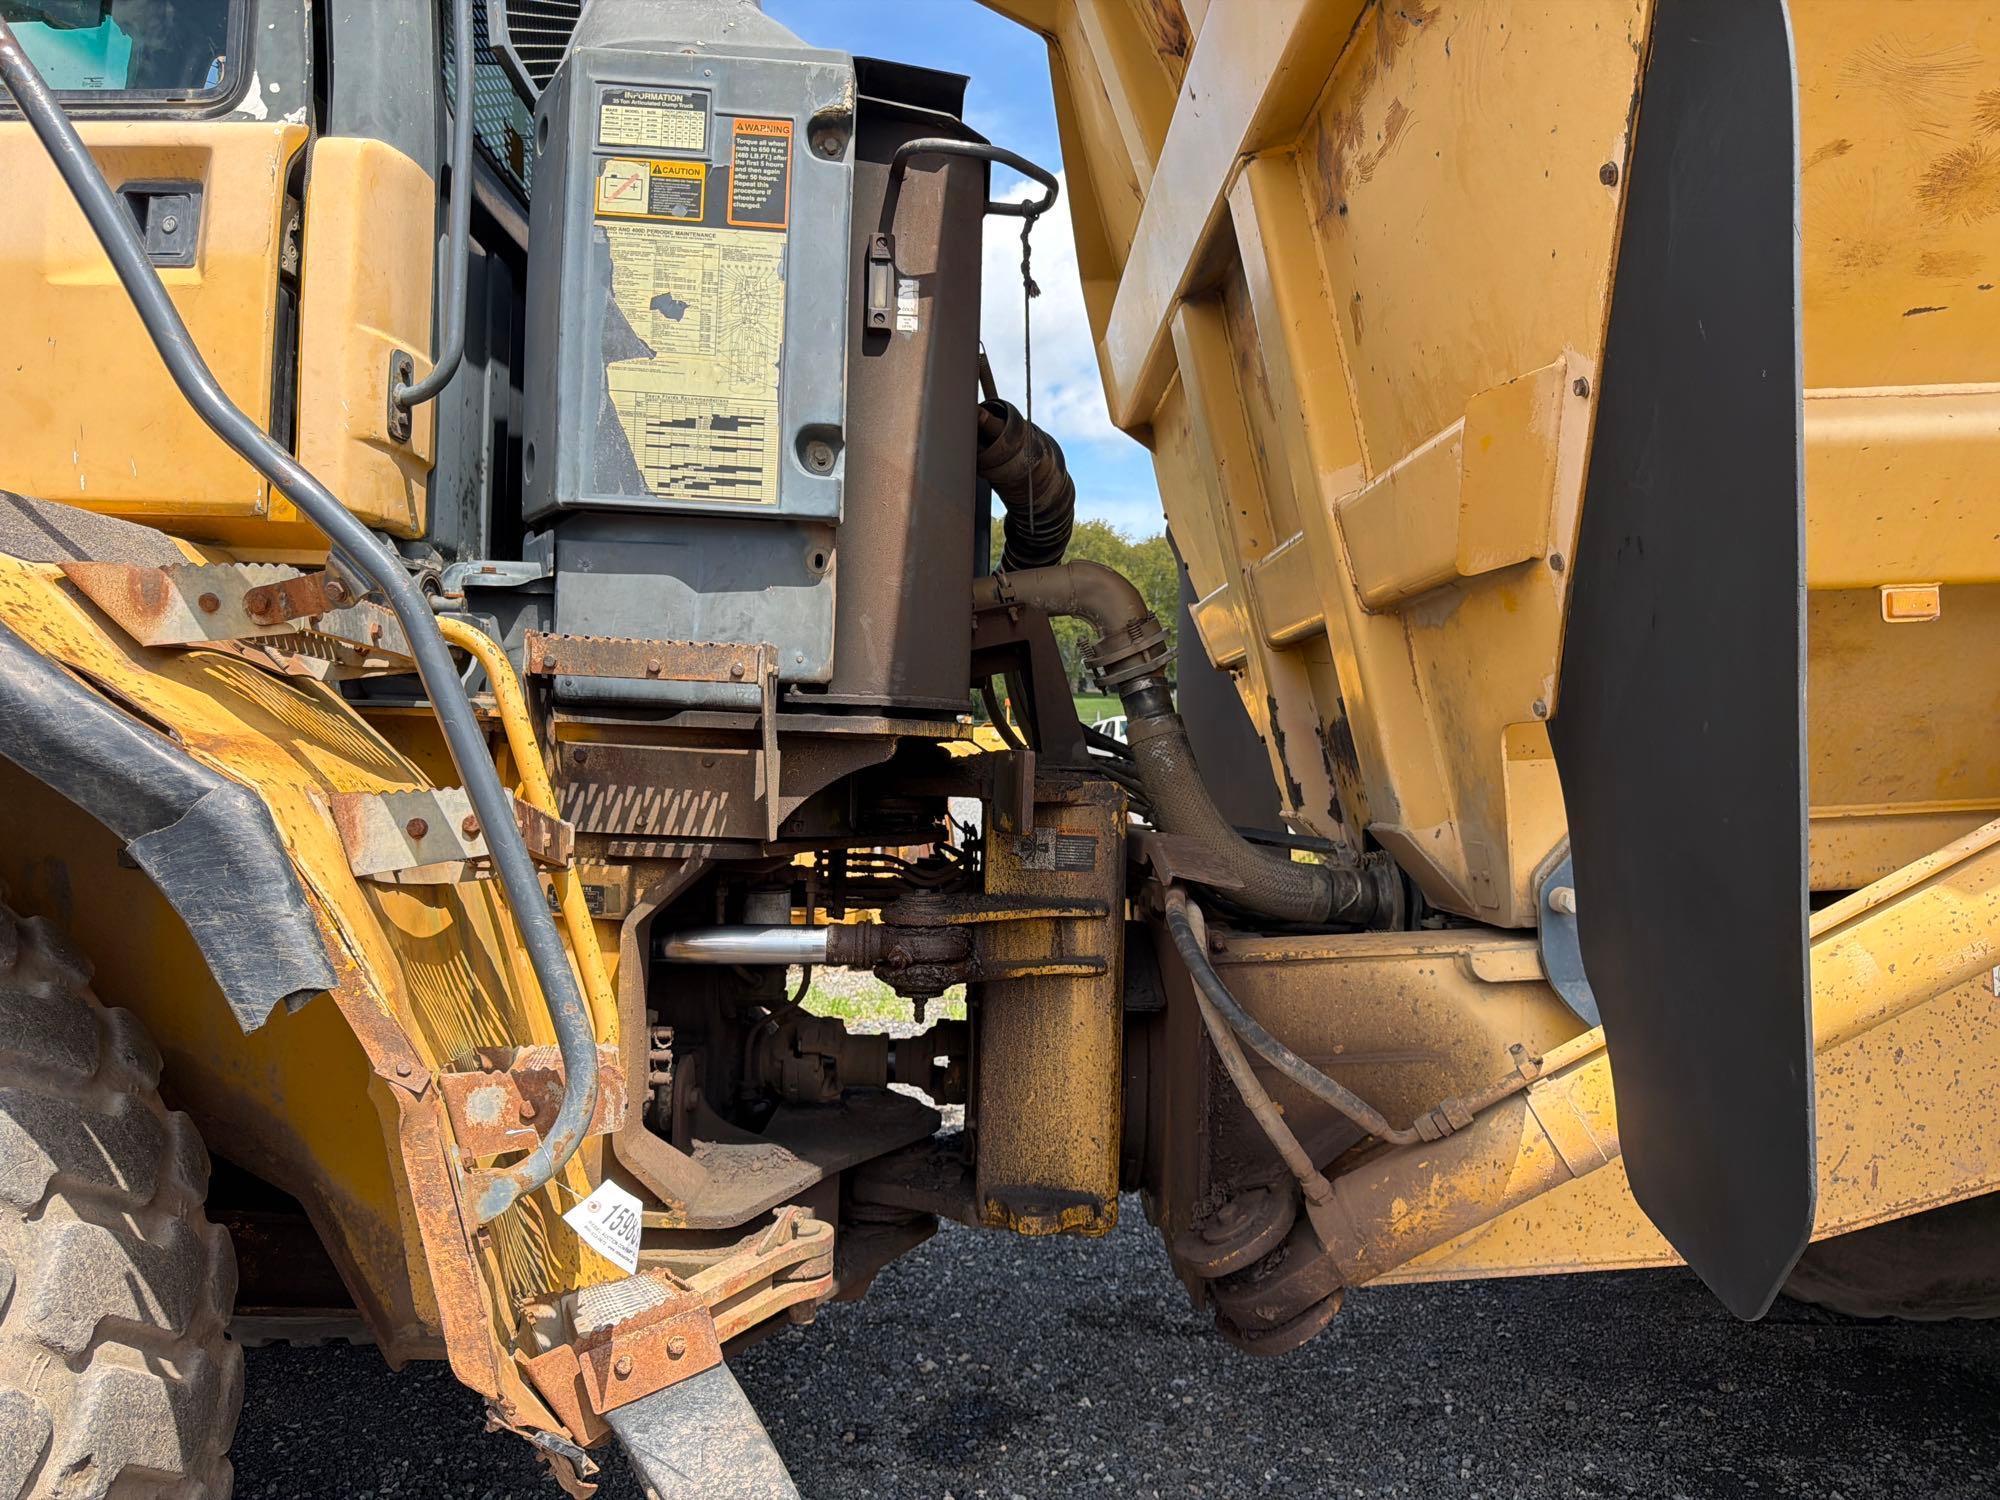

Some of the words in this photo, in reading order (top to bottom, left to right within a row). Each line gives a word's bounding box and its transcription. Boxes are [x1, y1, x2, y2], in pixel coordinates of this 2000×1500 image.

[624, 92, 683, 102] INFORMATION
[745, 124, 790, 133] WARNING
[663, 167, 700, 176] CAUTION
